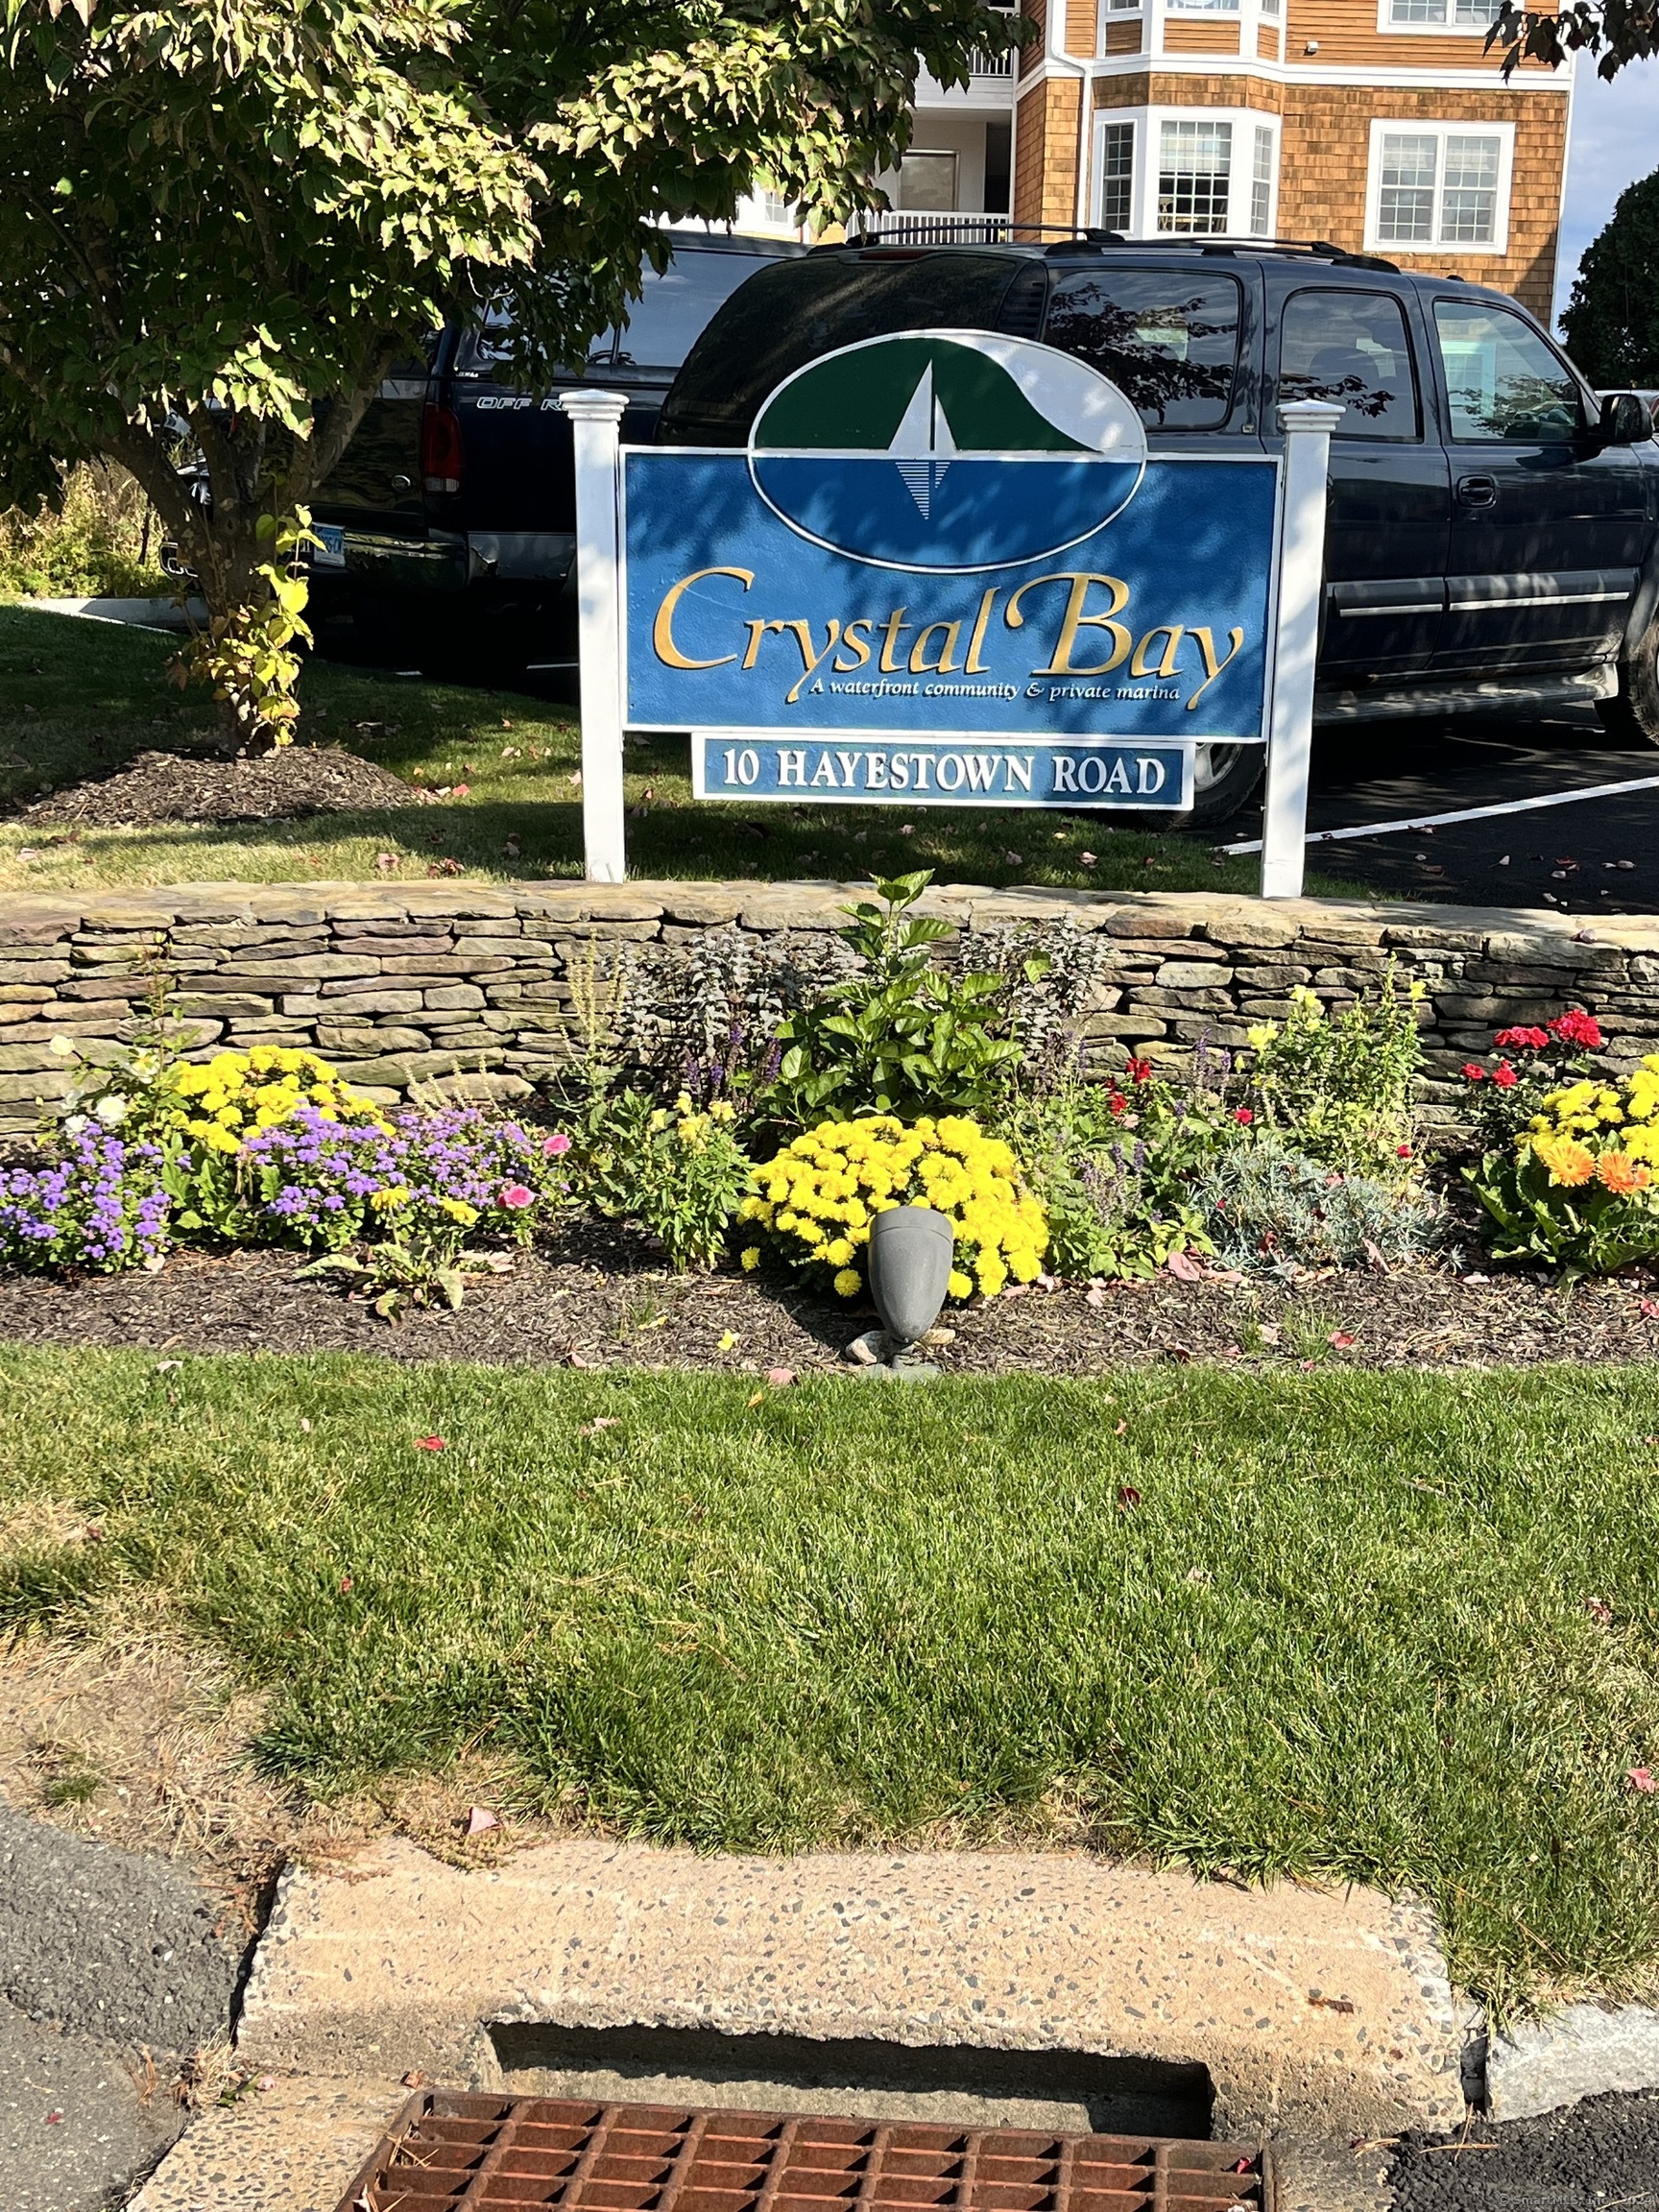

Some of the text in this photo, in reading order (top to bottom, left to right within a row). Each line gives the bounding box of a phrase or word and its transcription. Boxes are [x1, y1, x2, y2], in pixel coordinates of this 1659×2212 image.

[476, 397, 533, 410] OFF
[652, 566, 1244, 710] Crystal Bay
[810, 678, 1181, 702] A waterfront community & private marina
[723, 749, 1166, 794] 10 HAYESTOWN ROAD
